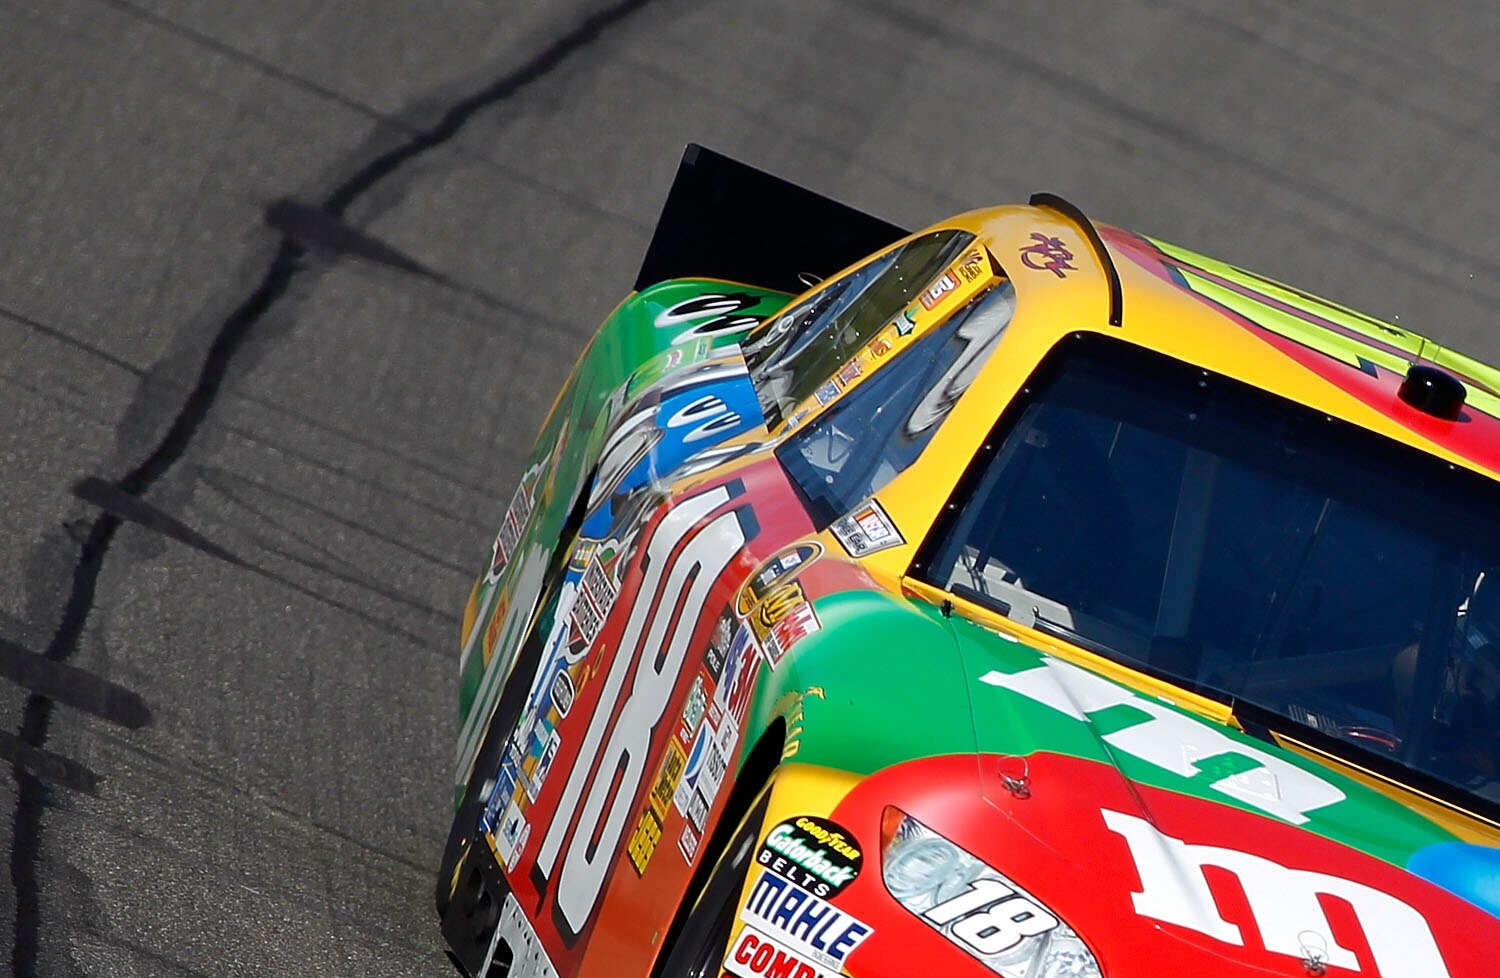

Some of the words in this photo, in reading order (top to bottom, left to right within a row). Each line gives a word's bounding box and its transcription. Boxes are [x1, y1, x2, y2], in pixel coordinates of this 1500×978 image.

[534, 482, 754, 942] 18
[759, 849, 831, 898] BELTS
[766, 823, 856, 888] Gatorback
[745, 870, 871, 962] MAHLE
[927, 876, 1059, 955] 18
